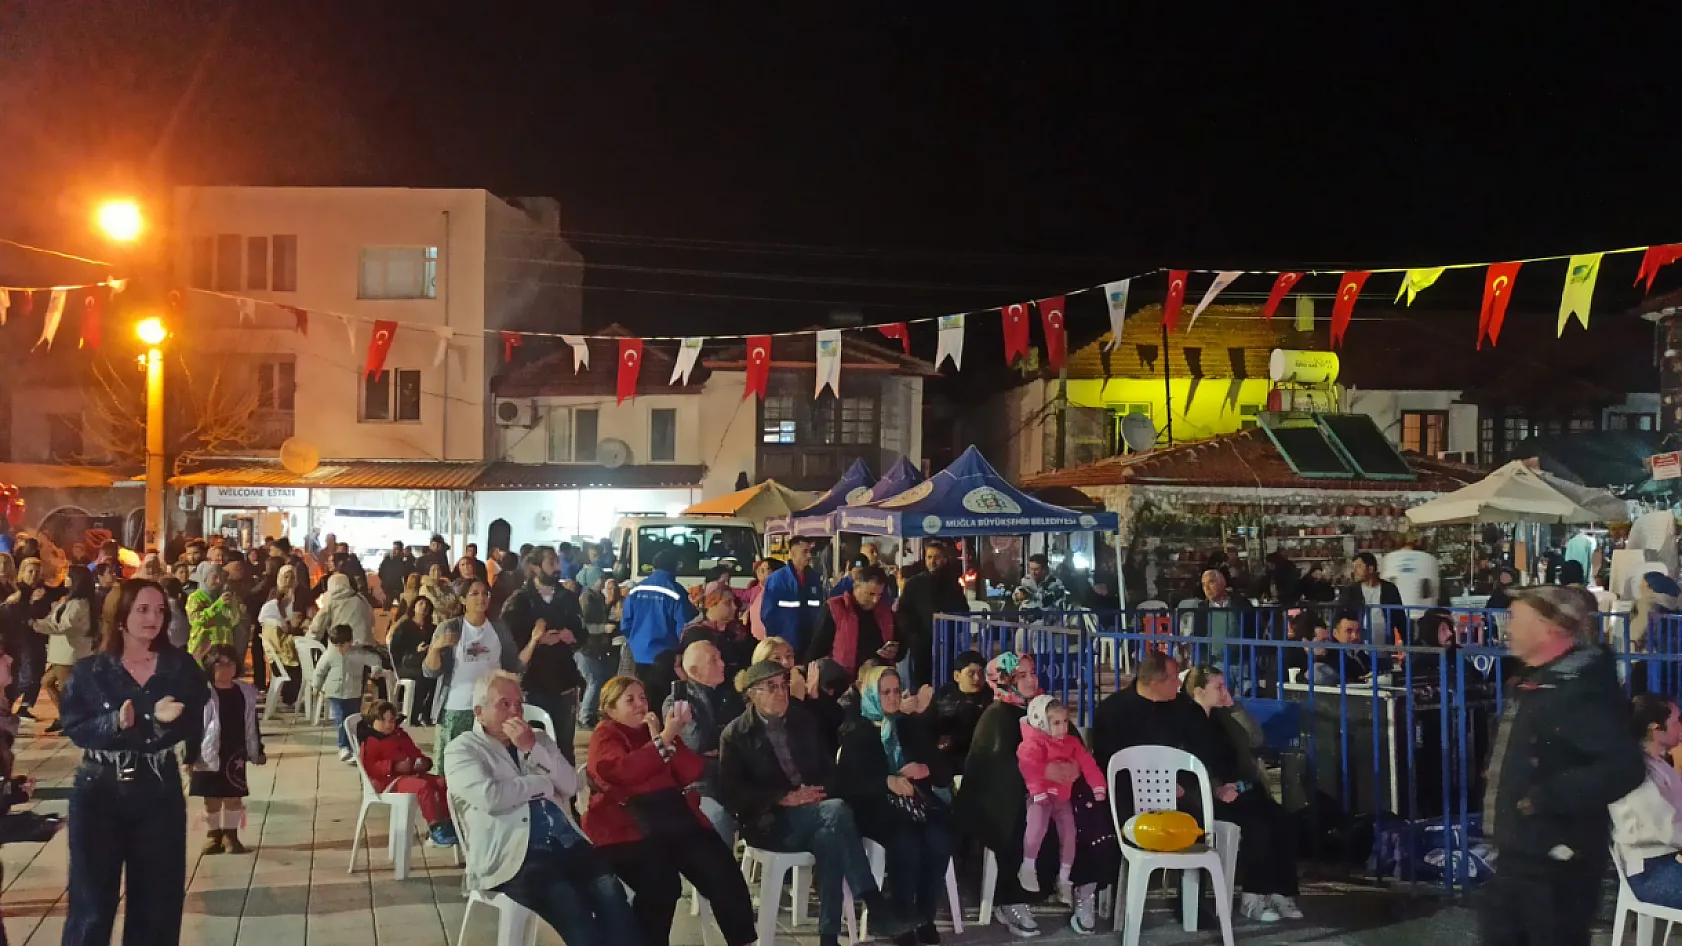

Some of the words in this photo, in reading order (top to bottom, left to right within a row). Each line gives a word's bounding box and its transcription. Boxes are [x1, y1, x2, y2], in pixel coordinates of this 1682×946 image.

[219, 489, 263, 497] WELCOME
[268, 489, 295, 497] ESTATE
[945, 517, 976, 527] MUĞLA
